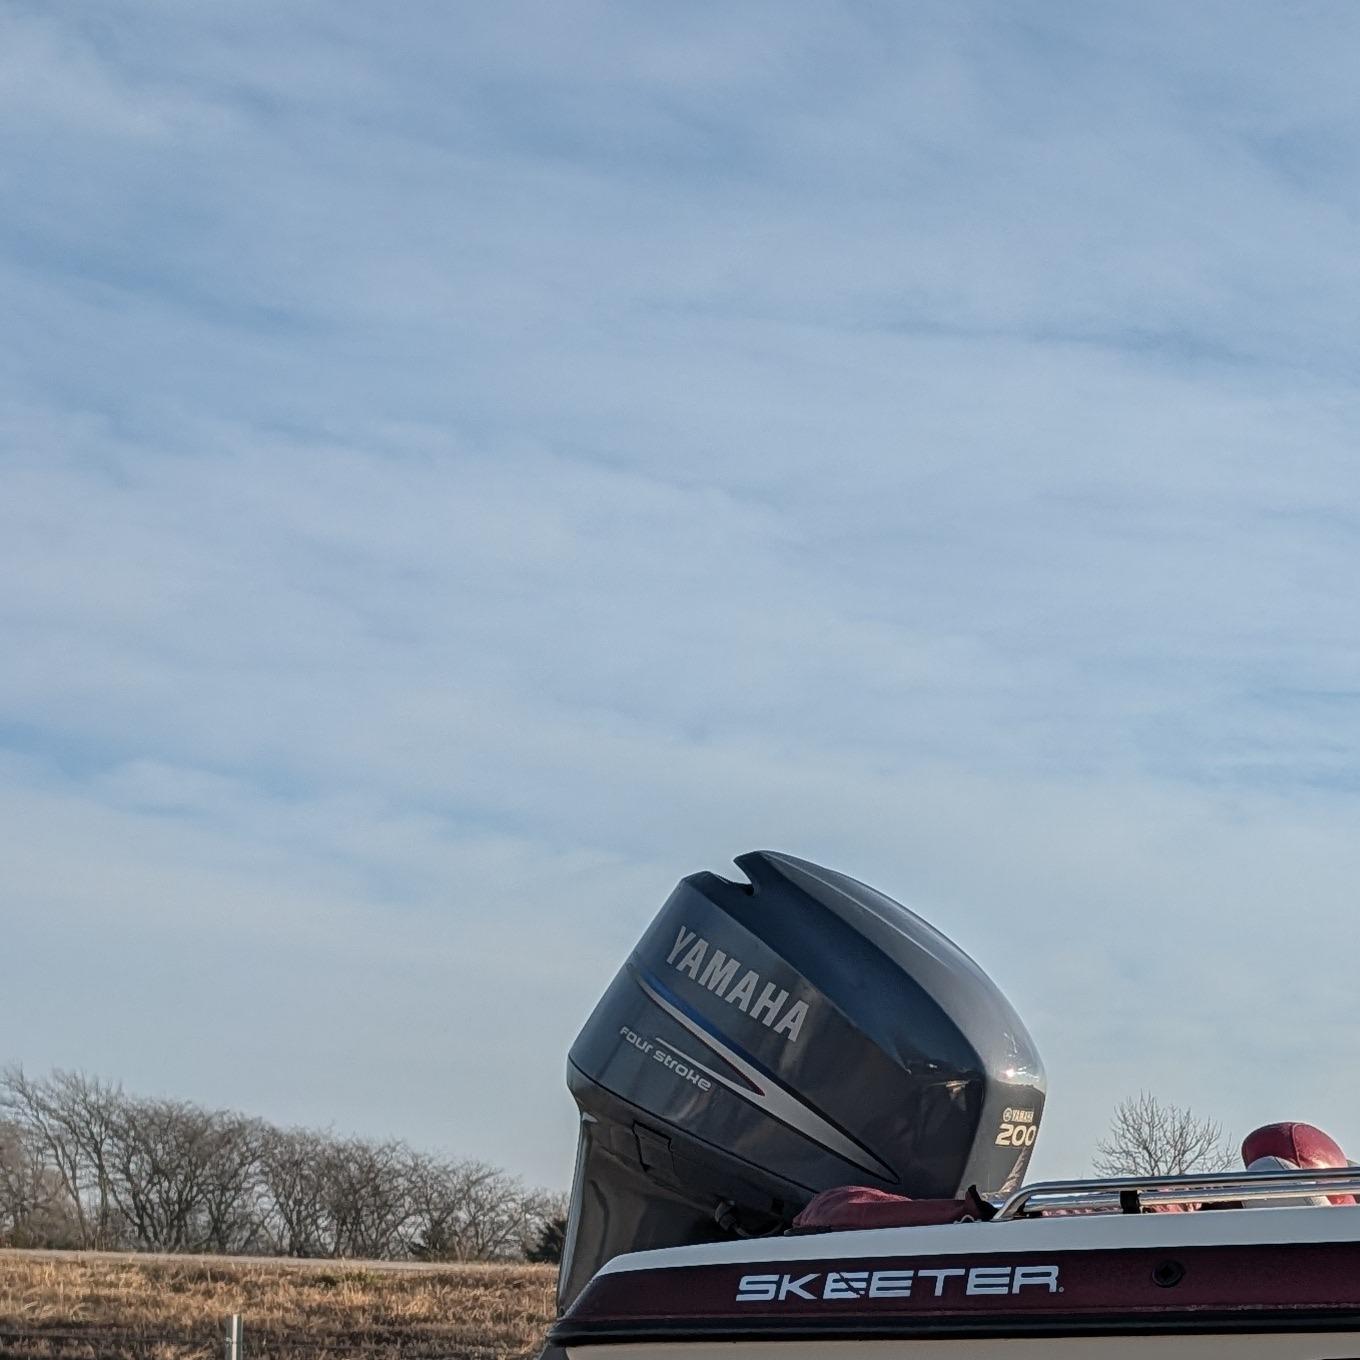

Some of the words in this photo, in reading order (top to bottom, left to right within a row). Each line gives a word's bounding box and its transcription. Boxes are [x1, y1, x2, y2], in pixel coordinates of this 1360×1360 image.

[665, 925, 811, 1042] YAMAHA
[995, 1123, 1037, 1147] 200
[735, 1264, 1060, 1302] SKEETER
